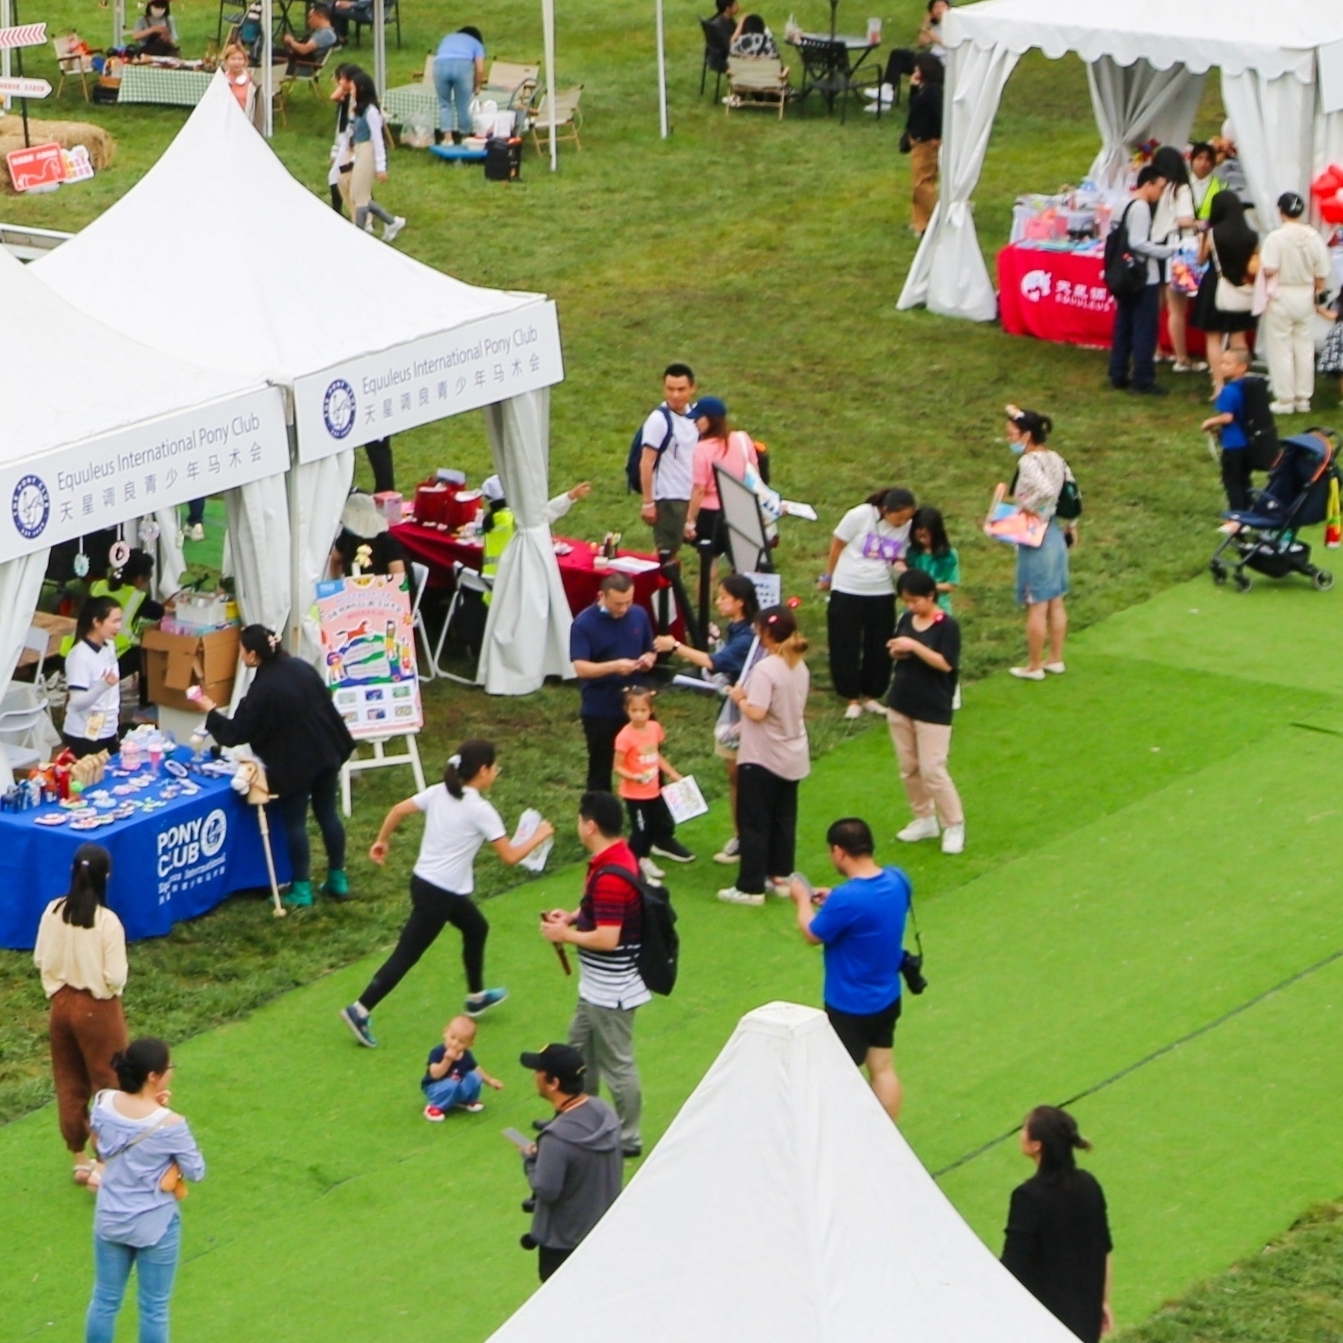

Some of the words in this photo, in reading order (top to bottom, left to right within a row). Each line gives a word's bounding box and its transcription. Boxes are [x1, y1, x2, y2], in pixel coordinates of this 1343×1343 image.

[363, 366, 412, 395] Equuleus
[414, 341, 482, 378] International
[485, 335, 511, 356] Pony
[513, 324, 538, 347] Club
[365, 352, 540, 425] 天星调良青少年马术会
[57, 462, 115, 493] Equuleus
[117, 430, 196, 472] International
[199, 423, 229, 447] Pony
[231, 412, 260, 436] Club
[60, 442, 263, 523] 天星调良青少年马术会
[157, 817, 203, 856] PONY
